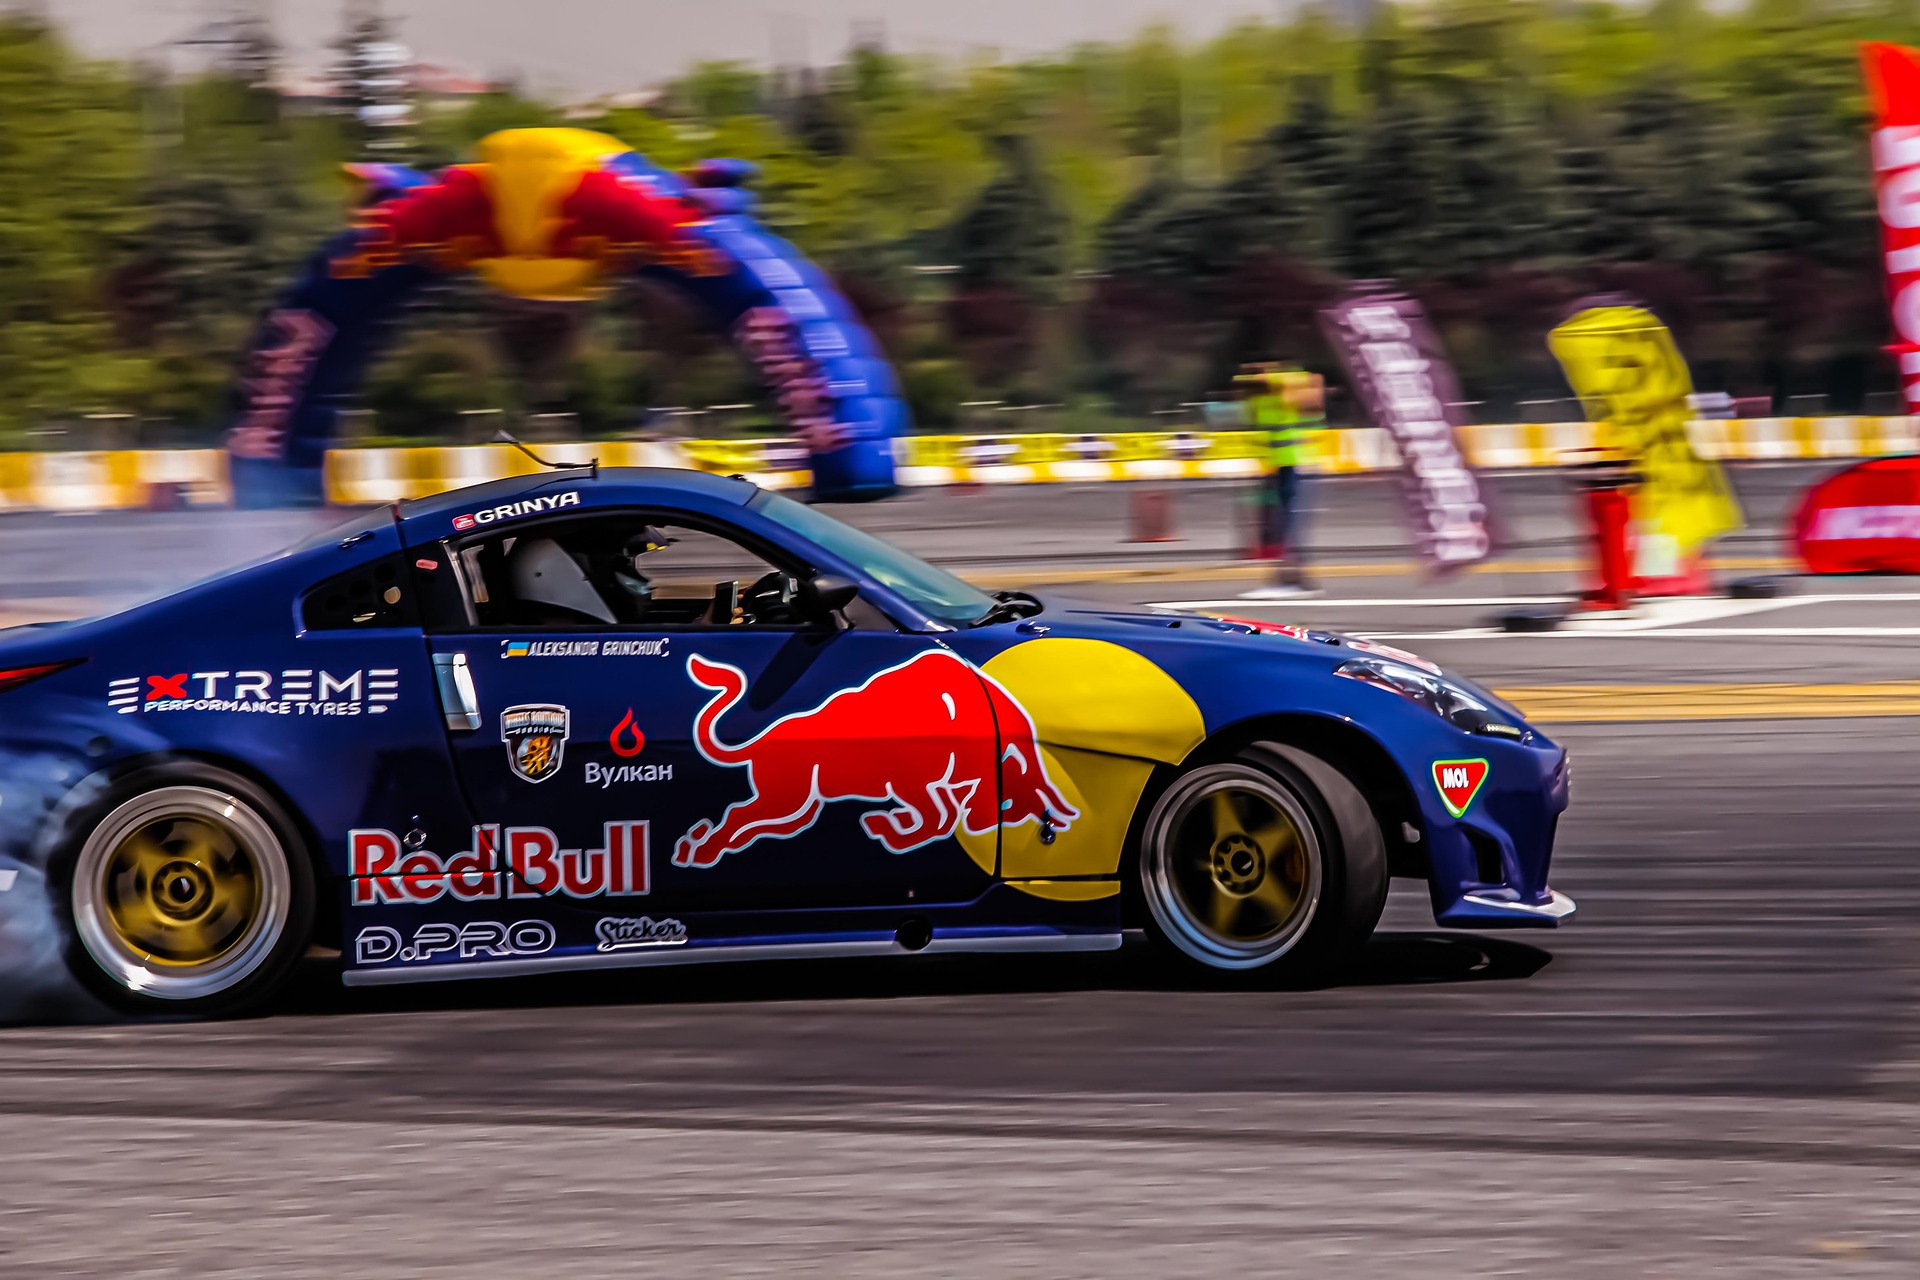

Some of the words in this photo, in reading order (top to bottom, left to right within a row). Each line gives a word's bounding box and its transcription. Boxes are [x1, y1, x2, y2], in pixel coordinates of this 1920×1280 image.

[474, 491, 580, 524] GRINYA
[528, 640, 599, 657] ALEKSANDR
[602, 639, 663, 656] GRINCHUK
[144, 699, 292, 714] PERFORMANCE
[295, 700, 362, 716] TYRES
[584, 762, 674, 789] Вулкан
[1442, 767, 1470, 789] MOL
[348, 823, 501, 906] Red
[505, 820, 650, 899] Bull
[355, 919, 556, 964] D.PRO
[596, 917, 688, 951] Sticker
